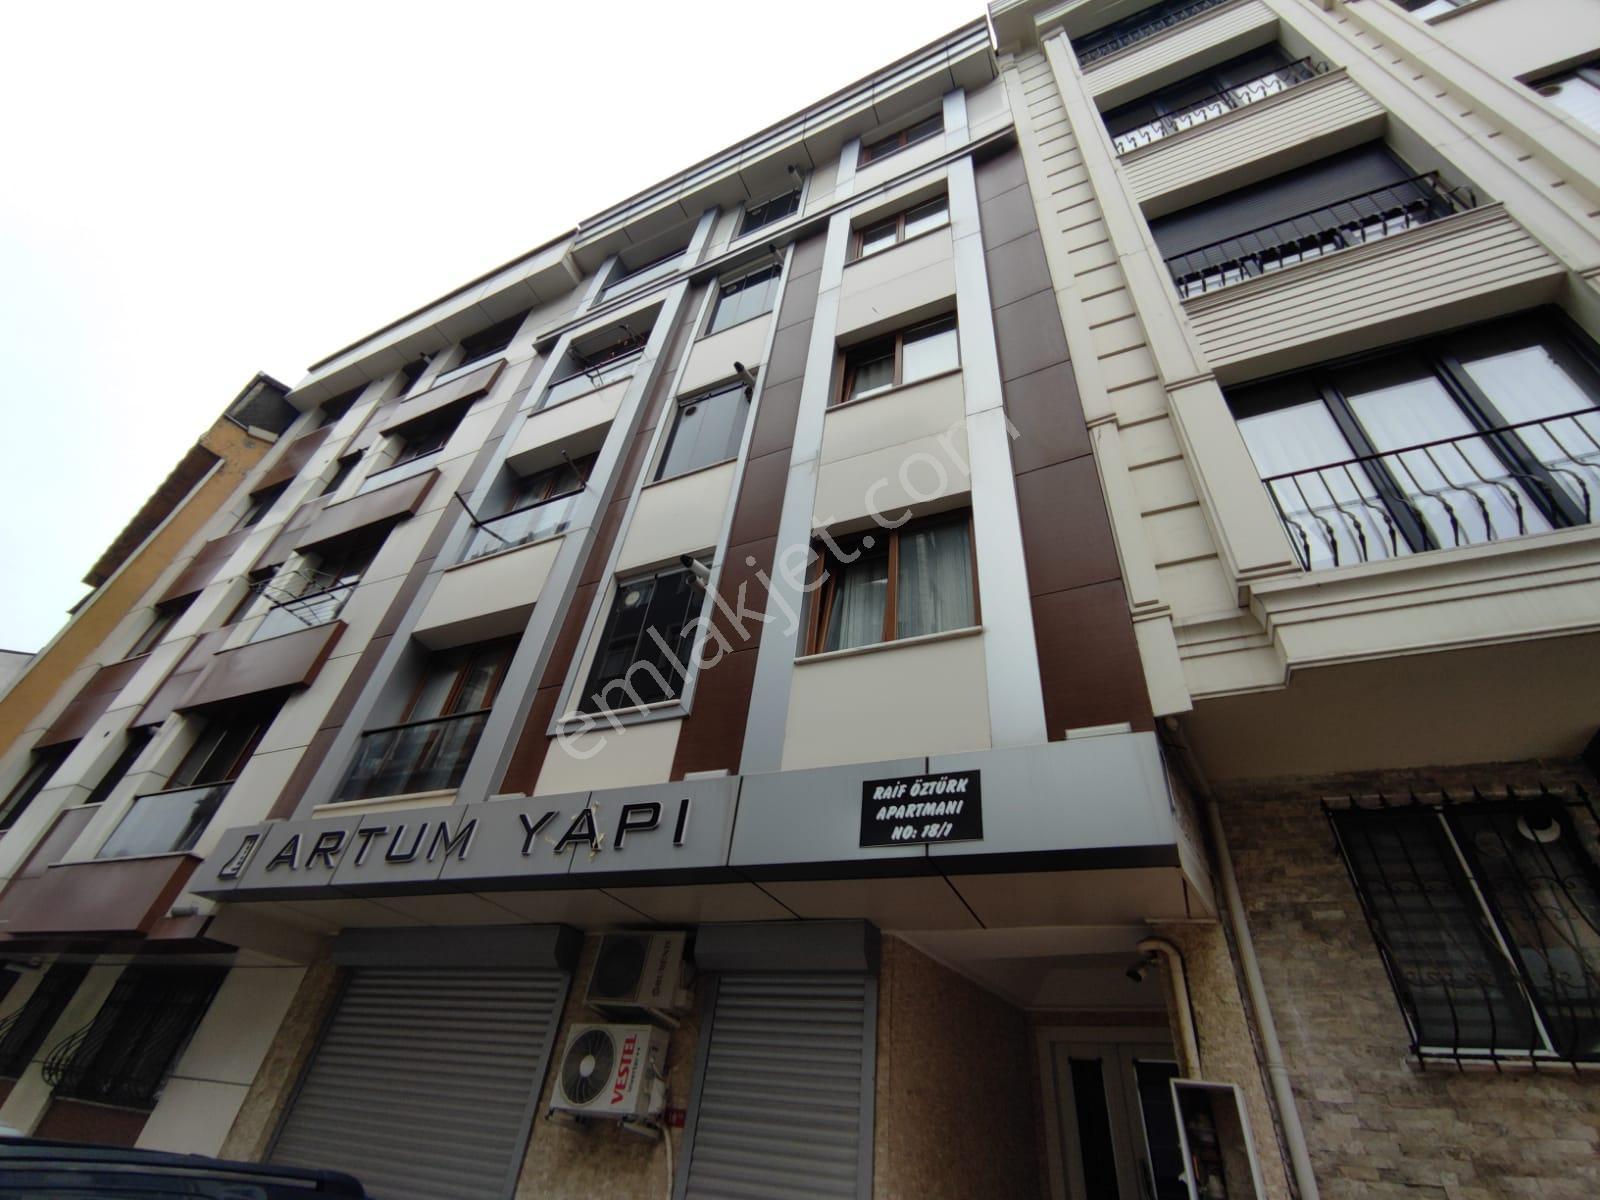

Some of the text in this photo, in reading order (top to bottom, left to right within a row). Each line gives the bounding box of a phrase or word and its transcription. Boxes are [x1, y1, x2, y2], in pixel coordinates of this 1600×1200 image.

[873, 776, 968, 800] RAİF ÖZTÜRK
[876, 800, 963, 820] APARTMANI
[266, 798, 690, 871] ARTUM YAPI
[891, 821, 953, 840] NO: 18/1
[611, 1034, 637, 1105] VESTEL
